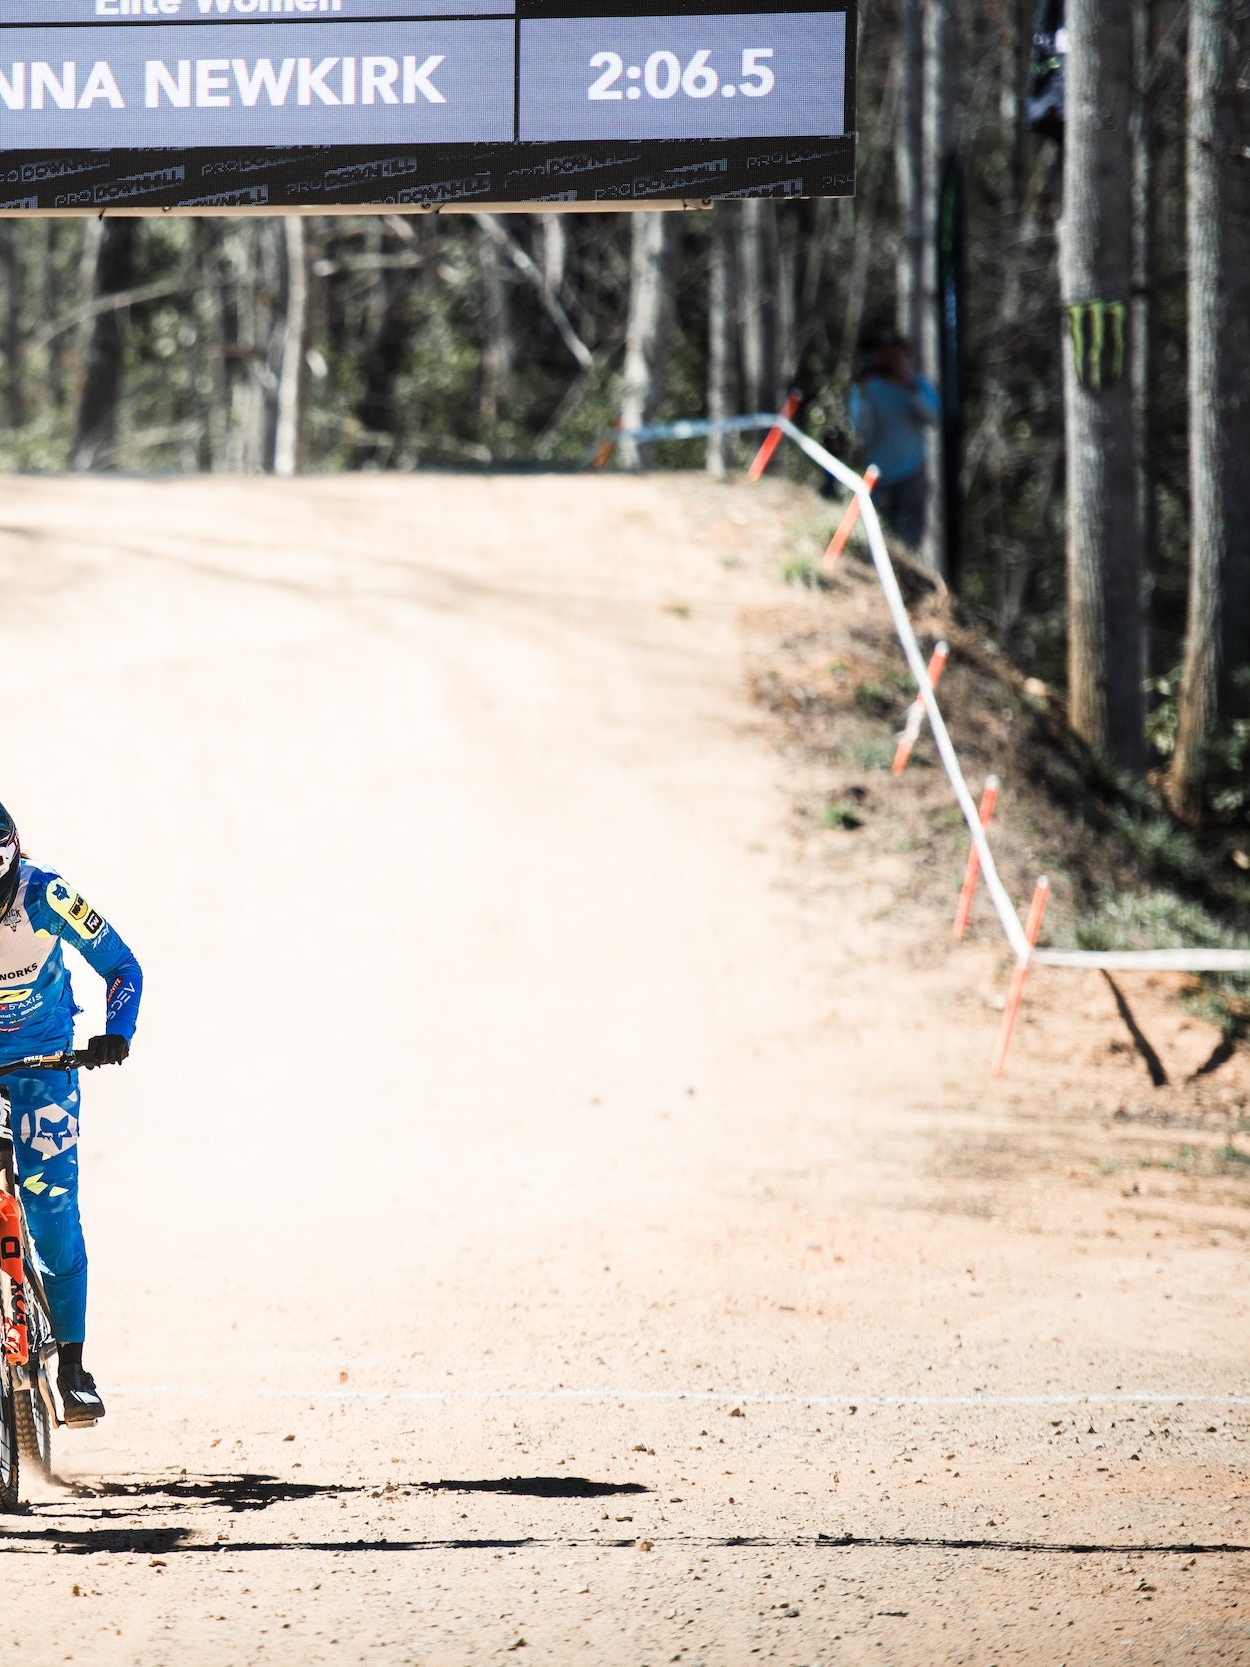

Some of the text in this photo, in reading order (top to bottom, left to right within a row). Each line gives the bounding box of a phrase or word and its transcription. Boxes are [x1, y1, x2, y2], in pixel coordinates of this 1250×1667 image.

[96, 0, 342, 15] Elite Women
[145, 55, 446, 108] NEWKIRK
[588, 48, 775, 101] 2:06.5
